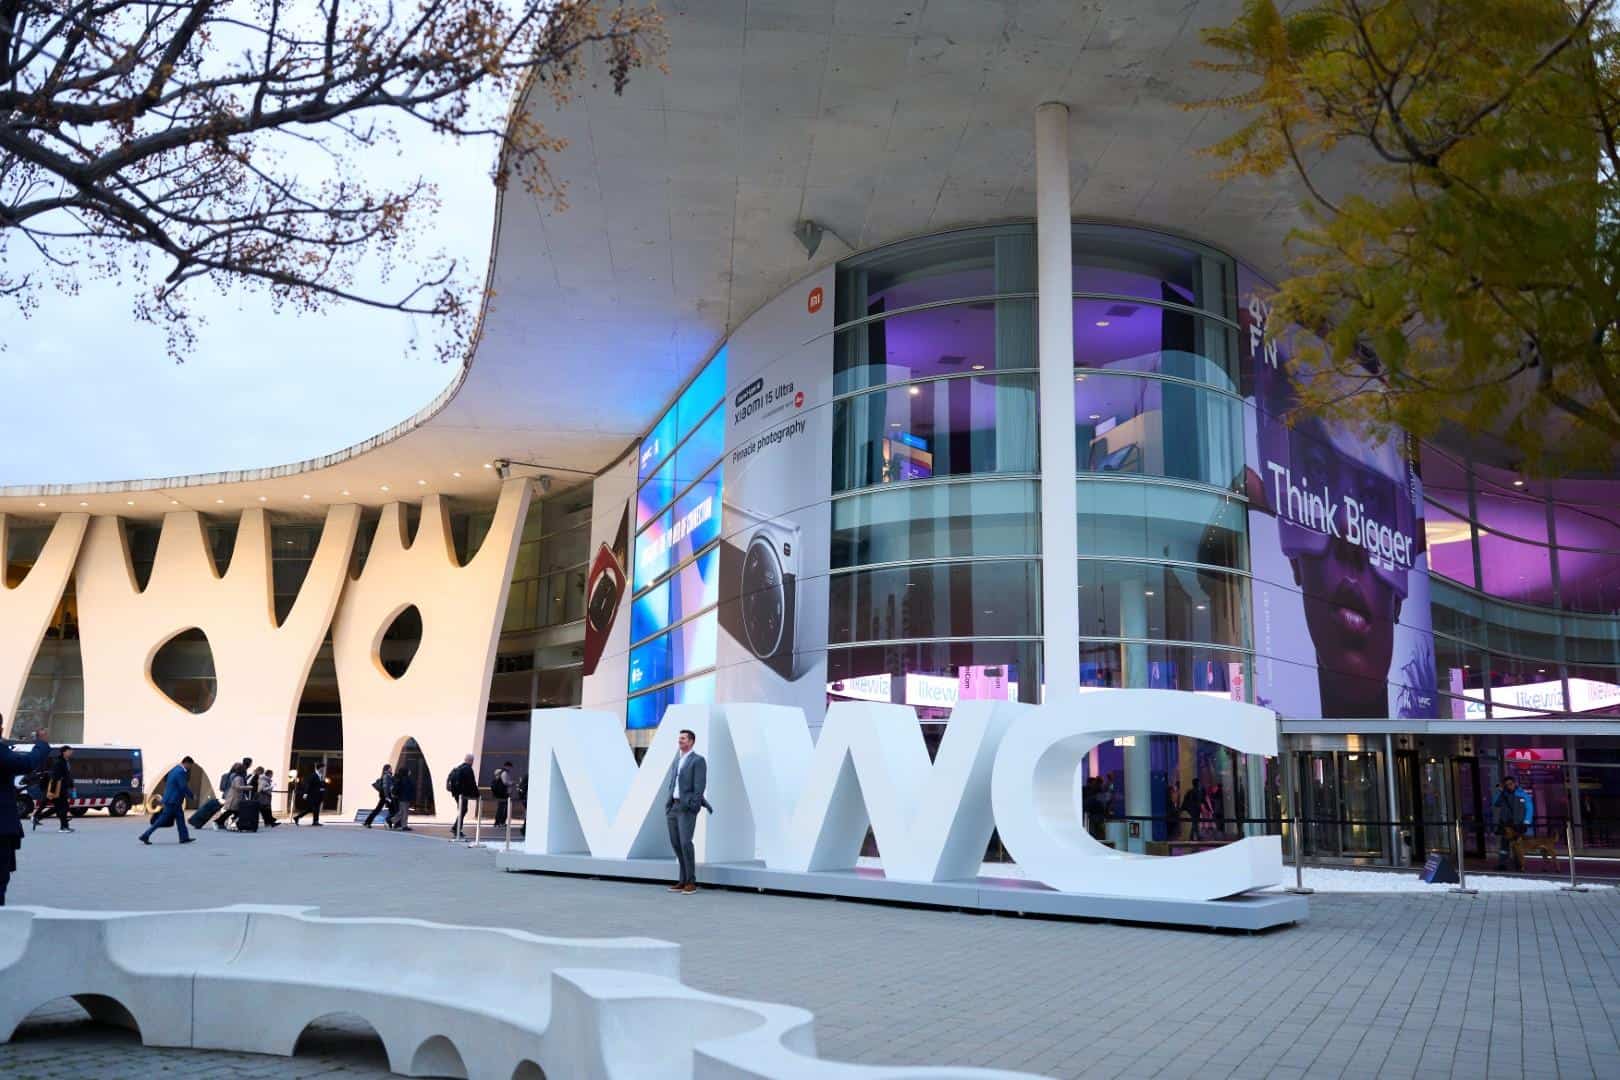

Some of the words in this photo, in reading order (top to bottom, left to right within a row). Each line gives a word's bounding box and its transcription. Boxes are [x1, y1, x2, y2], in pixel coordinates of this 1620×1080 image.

[765, 391, 773, 406] 15
[775, 382, 794, 400] Ultra
[757, 419, 806, 453] photography
[1267, 461, 1340, 538] Think
[1343, 495, 1413, 571] Bigger
[525, 688, 1283, 901] MWC
